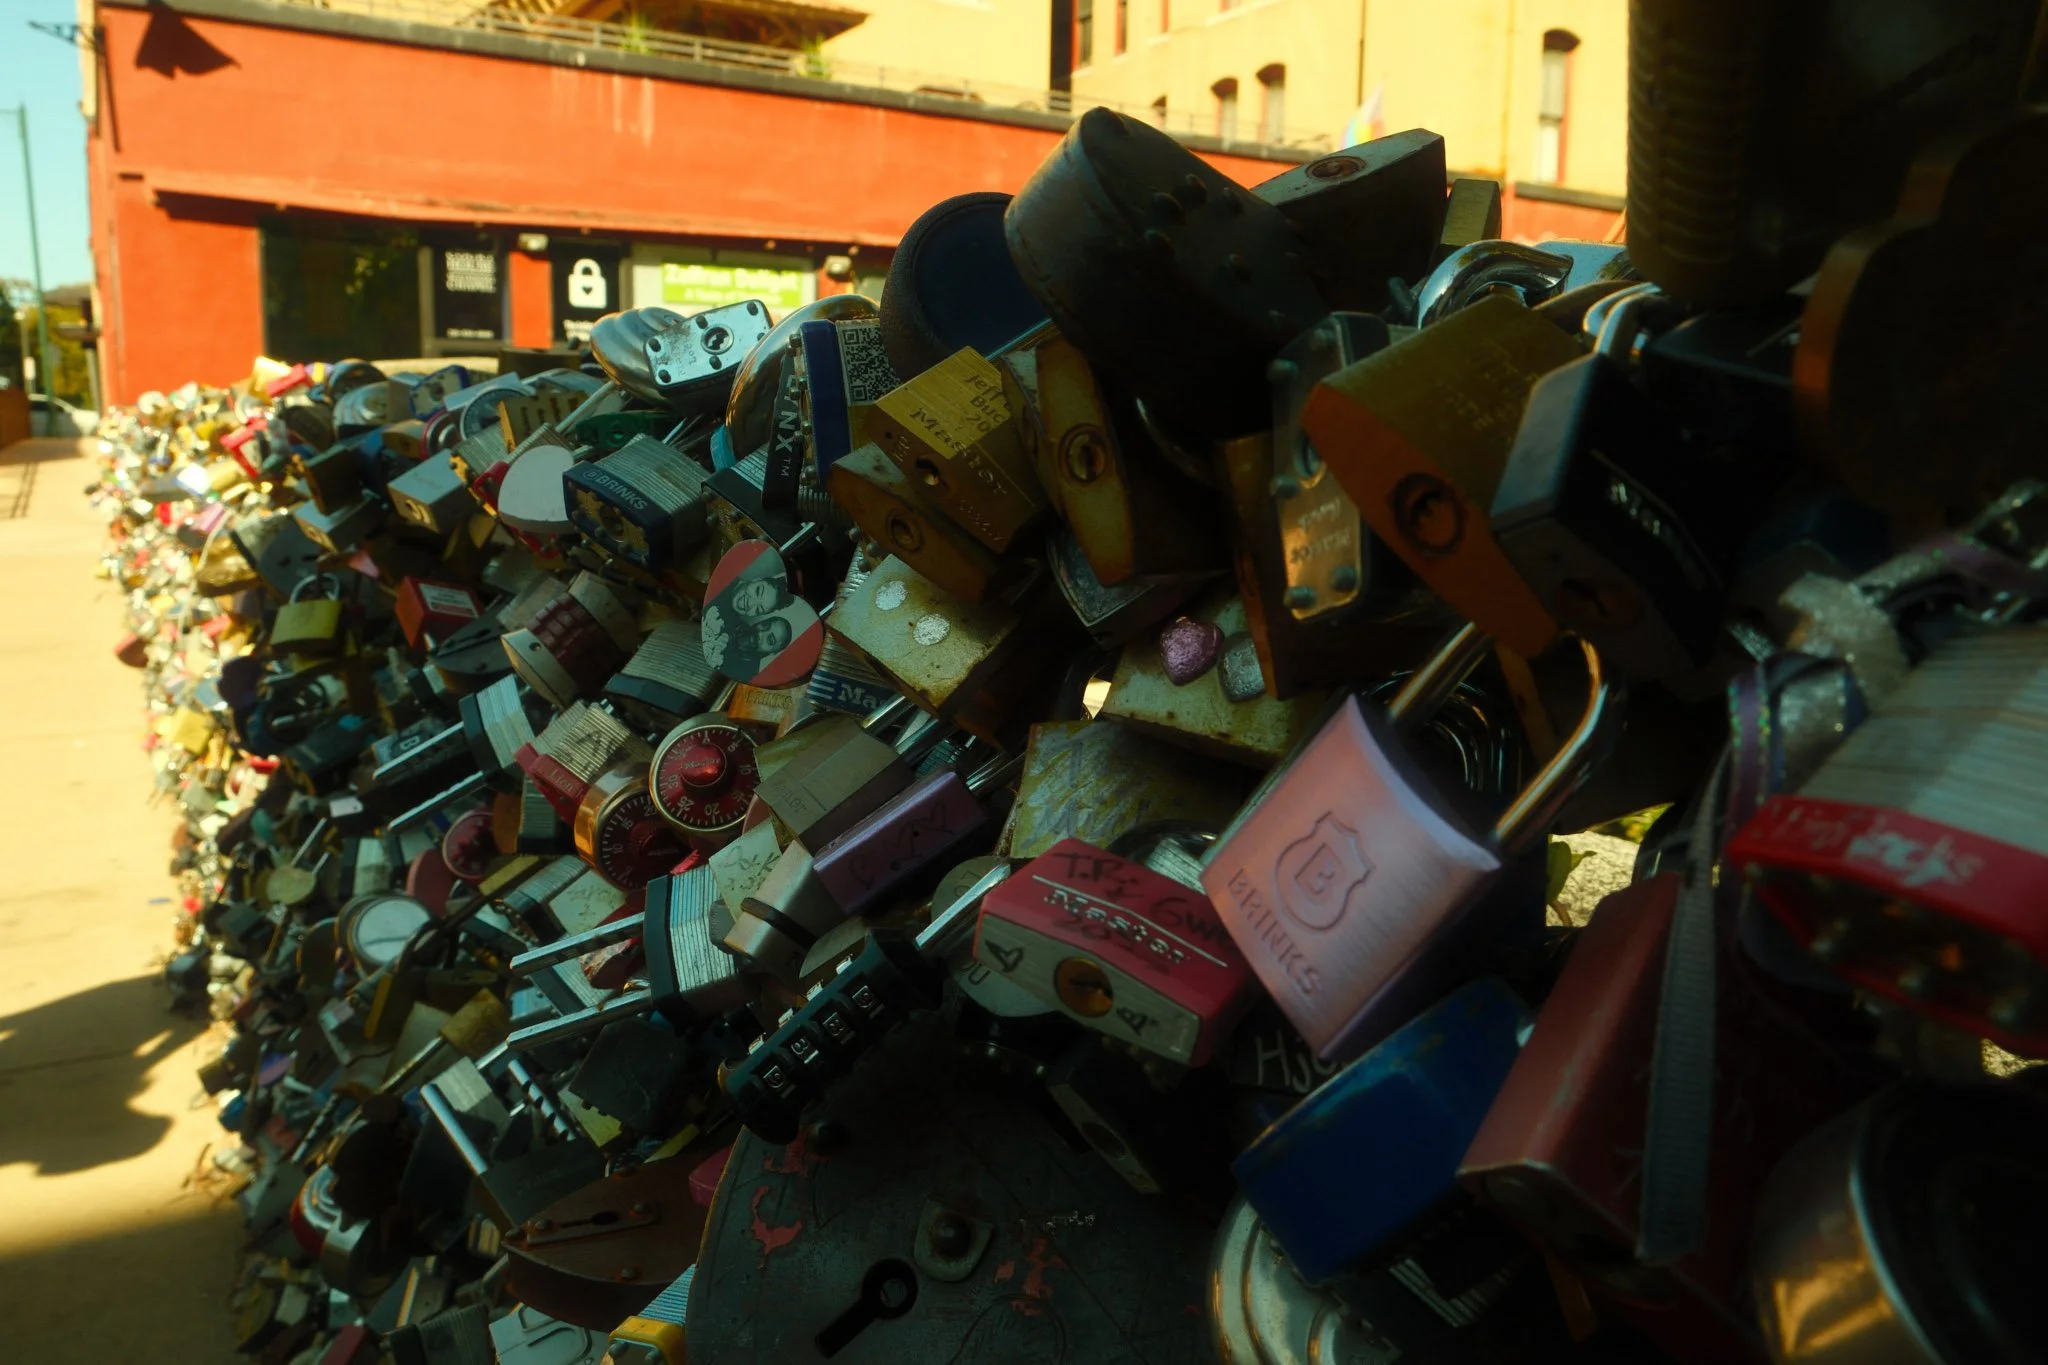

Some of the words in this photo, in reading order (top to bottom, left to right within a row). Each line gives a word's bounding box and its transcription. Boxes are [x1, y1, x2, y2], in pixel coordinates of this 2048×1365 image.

[595, 475, 648, 510] BRINKS
[909, 406, 1008, 496] Master
[1042, 887, 1191, 965] Master
[1227, 868, 1324, 998] BRINKS
